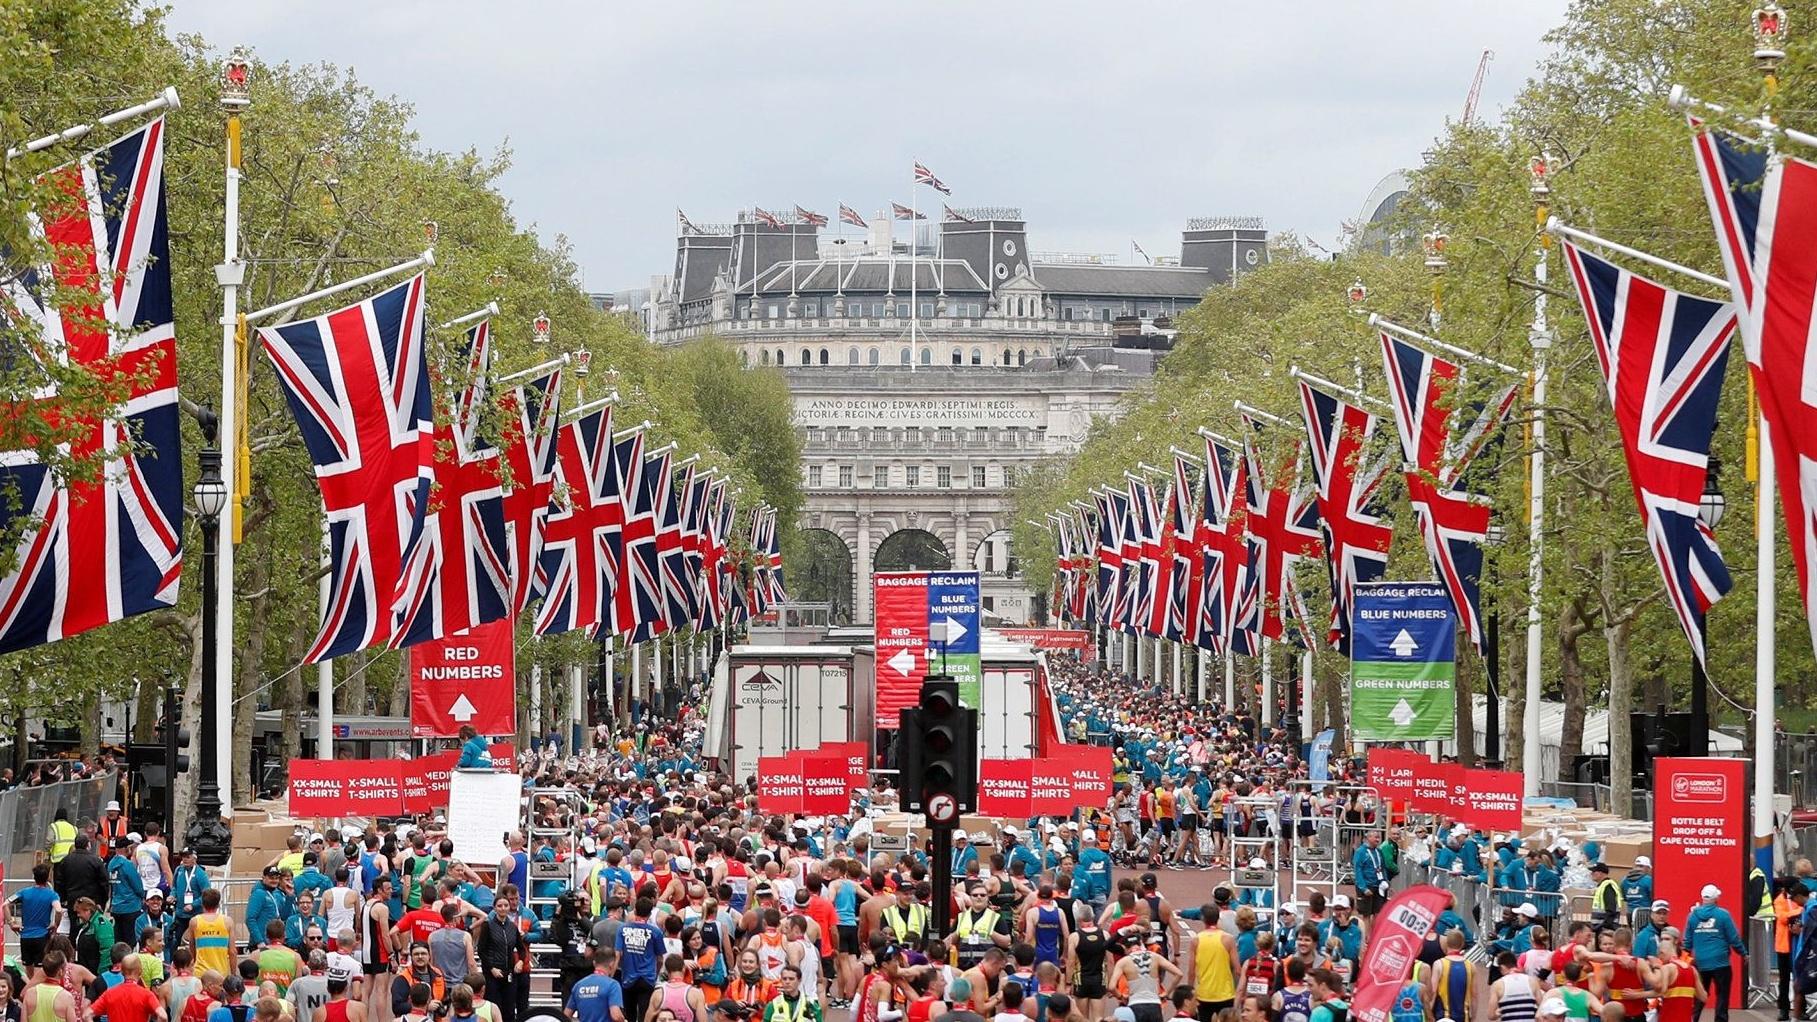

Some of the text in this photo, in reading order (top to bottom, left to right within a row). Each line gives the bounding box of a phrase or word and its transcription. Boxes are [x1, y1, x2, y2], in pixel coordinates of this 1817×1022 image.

[811, 400, 843, 409] ANNO
[847, 400, 888, 409] DECIMO
[892, 400, 937, 409] EDWARDI
[941, 400, 982, 409] SEPTIMI
[889, 410, 921, 419] CIVES
[926, 410, 983, 419] GRATISSIMI
[877, 577, 976, 586] BAGGAGE RECLAIM
[1355, 588, 1445, 597] BAGGAGE RECLAI
[941, 595, 966, 603] BLUE
[931, 605, 976, 614] NUMBERS
[1360, 609, 1447, 619] BLUE NUMBERS
[891, 628, 910, 636] RED
[878, 638, 923, 646] NUMBERS
[444, 647, 479, 661] RED
[421, 664, 503, 680] NUMBERS
[954, 675, 977, 683] BERS
[1355, 679, 1450, 689] GREEN NUMBERS
[492, 758, 511, 766] RGE
[293, 779, 342, 788] XX-SMALL
[347, 777, 398, 787] X-SMALL
[405, 777, 423, 785] SMALL
[805, 777, 846, 786] XX-SMALL
[983, 779, 1029, 789] XX-SMALL
[296, 789, 340, 798] T-SHIRTS
[348, 788, 399, 799] T-SHIRTS
[403, 788, 427, 797] T-SHIRTS
[807, 786, 844, 796] T-SHIRTS
[985, 789, 1026, 798] T-SHIRTS
[1414, 789, 1447, 798] T-SHIR
[1468, 791, 1519, 802] XX-SMALL
[1471, 801, 1516, 811] T-SHIRTS
[1671, 817, 1725, 826] BOTTLE BELT
[1683, 837, 1736, 846] COLLECTION
[1684, 847, 1710, 855] POINT
